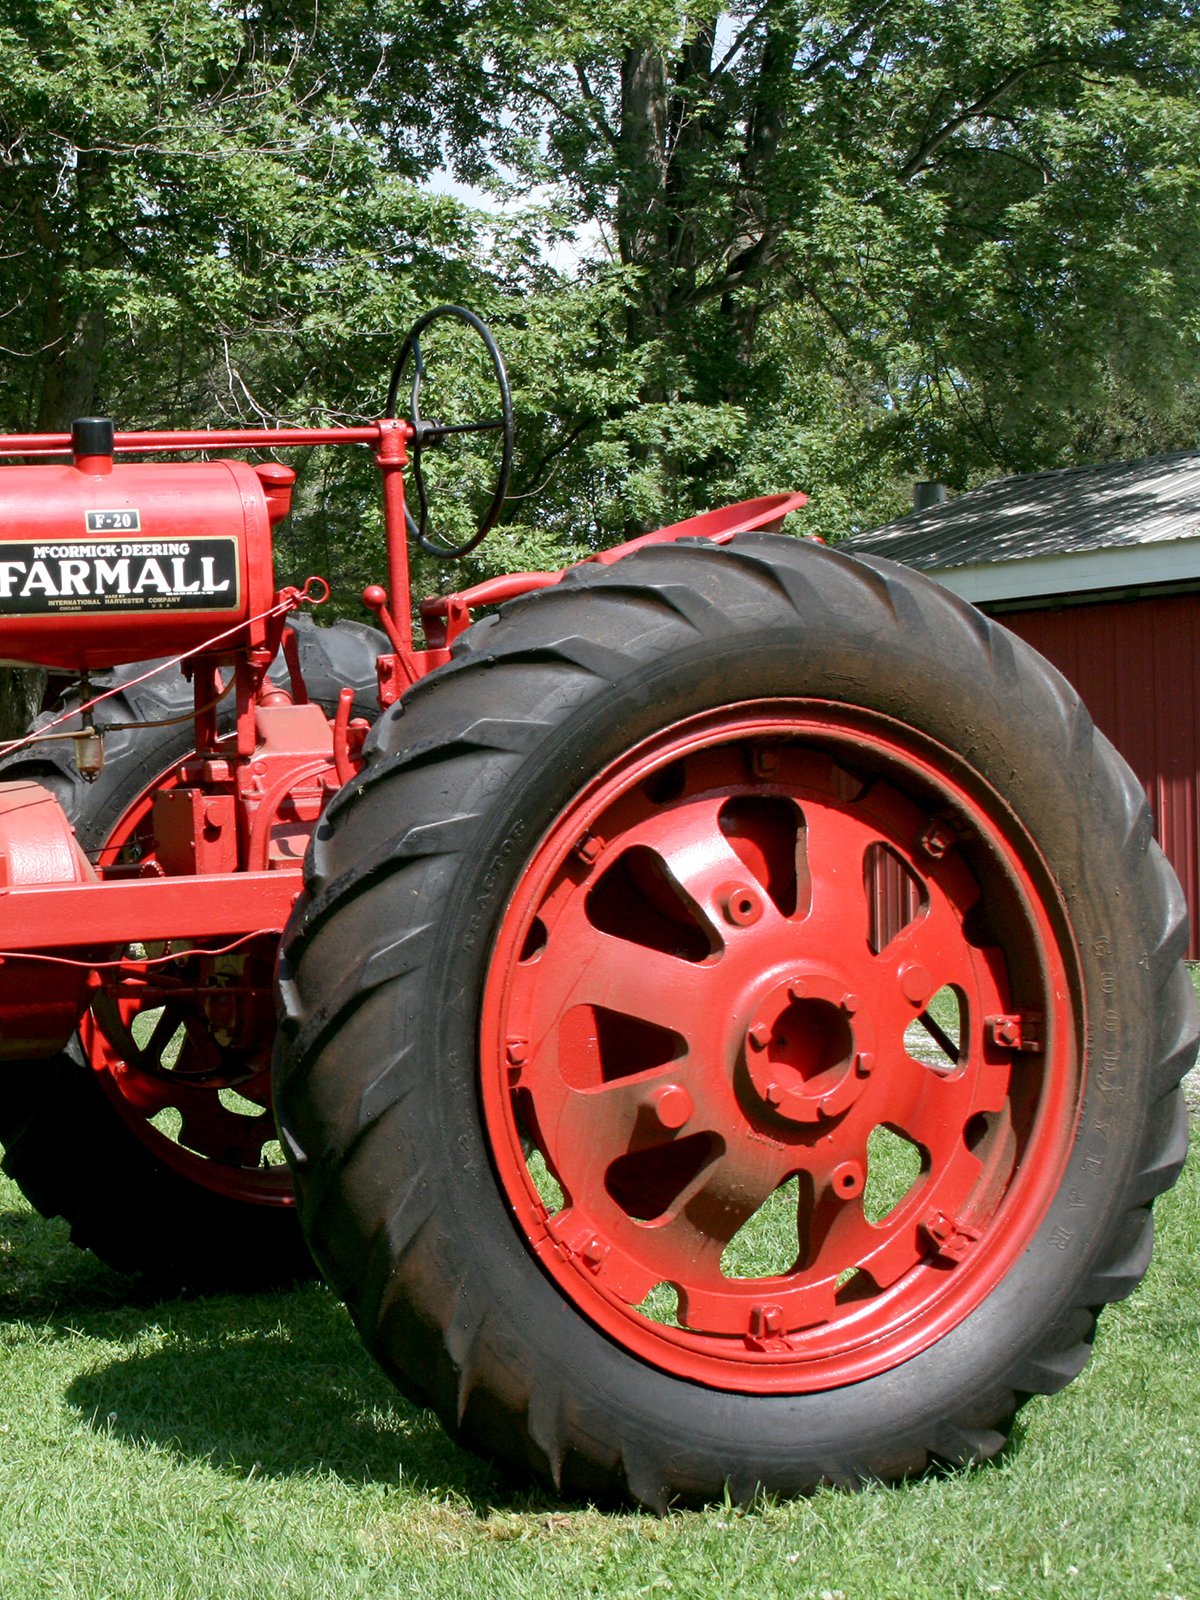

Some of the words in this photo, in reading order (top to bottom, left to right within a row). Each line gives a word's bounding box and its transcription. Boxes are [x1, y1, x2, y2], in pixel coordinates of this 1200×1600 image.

[94, 513, 132, 529] F-20
[47, 599, 101, 607] INTERNATIONAL
[104, 597, 145, 605] HARVESTER
[147, 596, 181, 604] COMPANY
[462, 817, 526, 951] TRACTOR
